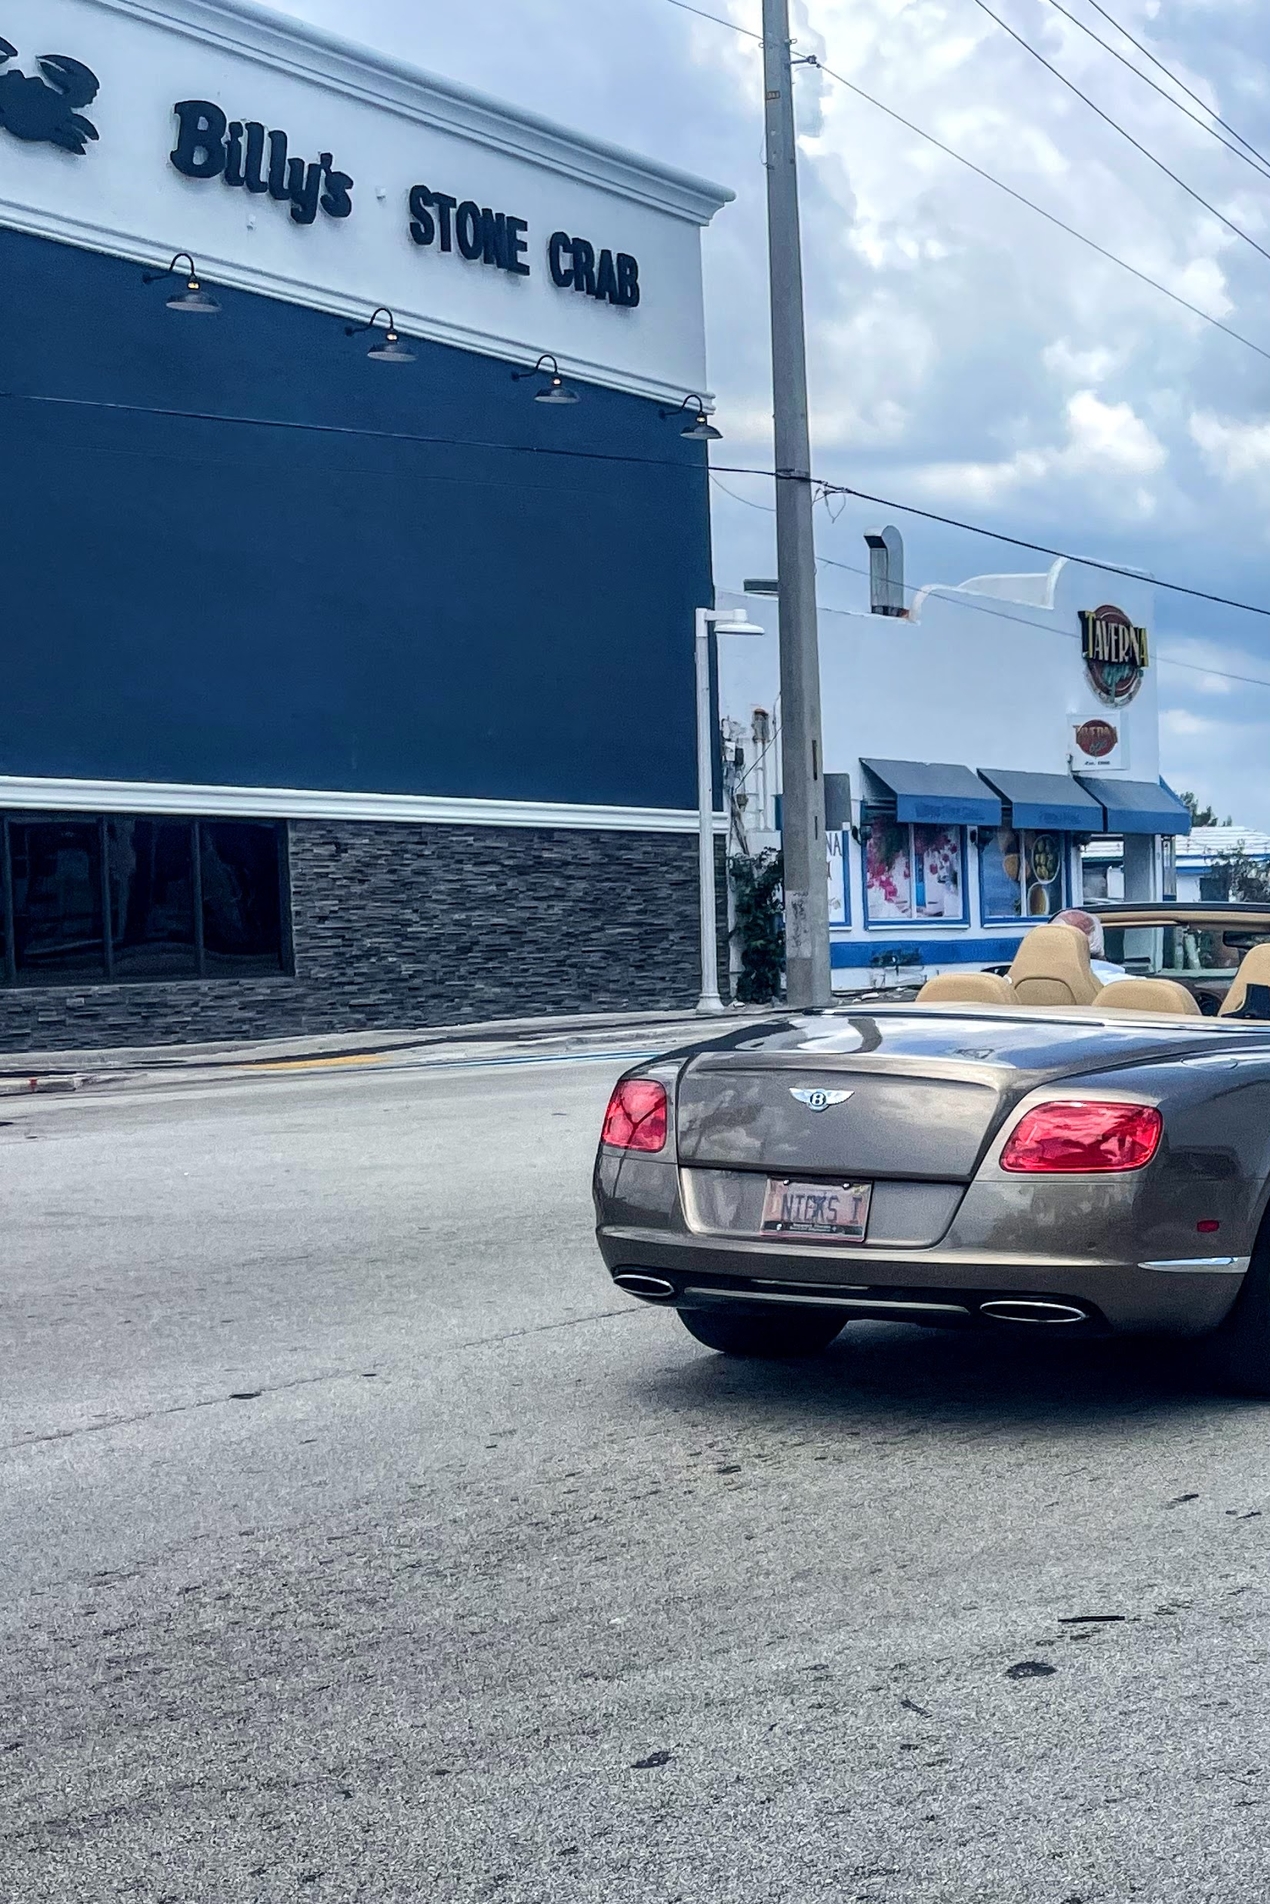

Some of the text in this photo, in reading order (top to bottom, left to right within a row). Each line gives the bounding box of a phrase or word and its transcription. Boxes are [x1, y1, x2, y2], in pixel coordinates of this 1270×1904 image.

[170, 99, 640, 308] Billy's STONE CRAB
[1081, 610, 1149, 668] TAVERNA
